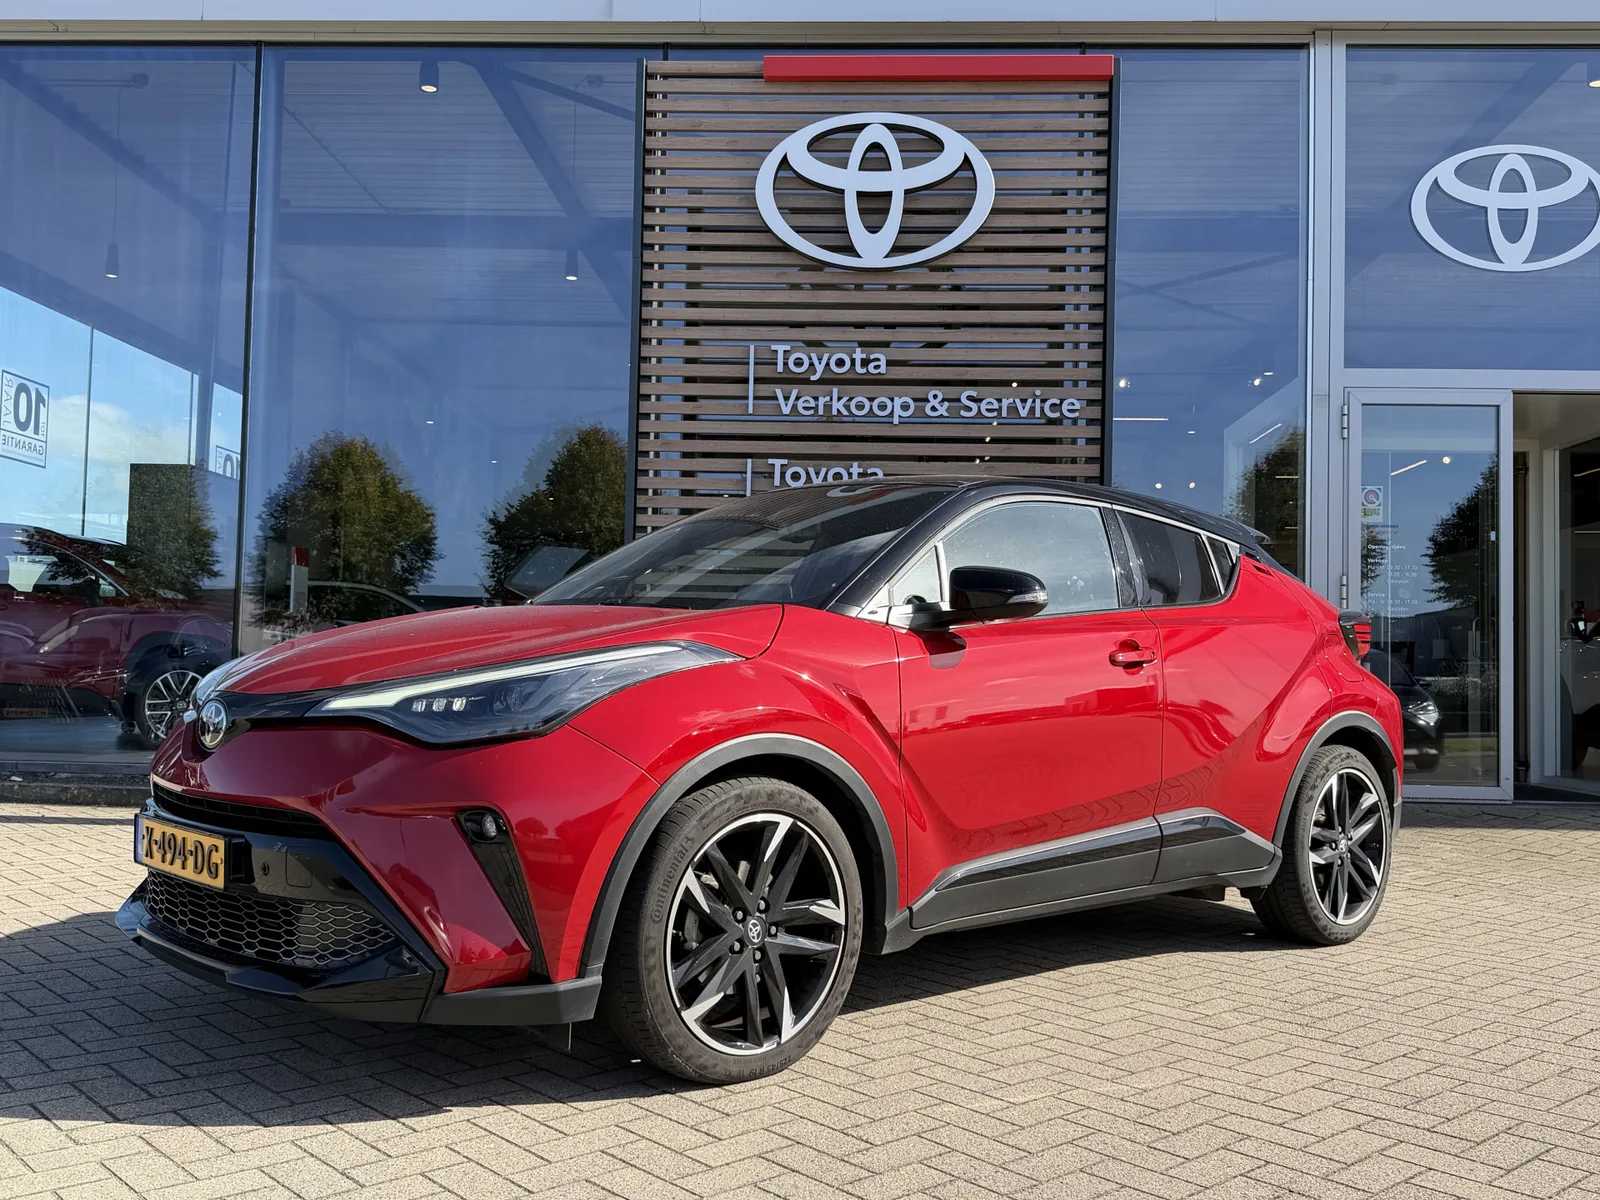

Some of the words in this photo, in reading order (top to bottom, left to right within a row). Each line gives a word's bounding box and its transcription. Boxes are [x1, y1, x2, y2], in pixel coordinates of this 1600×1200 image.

[771, 345, 887, 380] Toyota
[775, 388, 915, 425] Verkoop
[924, 390, 949, 417] &
[959, 389, 1081, 418] Service
[145, 826, 219, 879] X-494-DG
[650, 843, 689, 924] Continental
